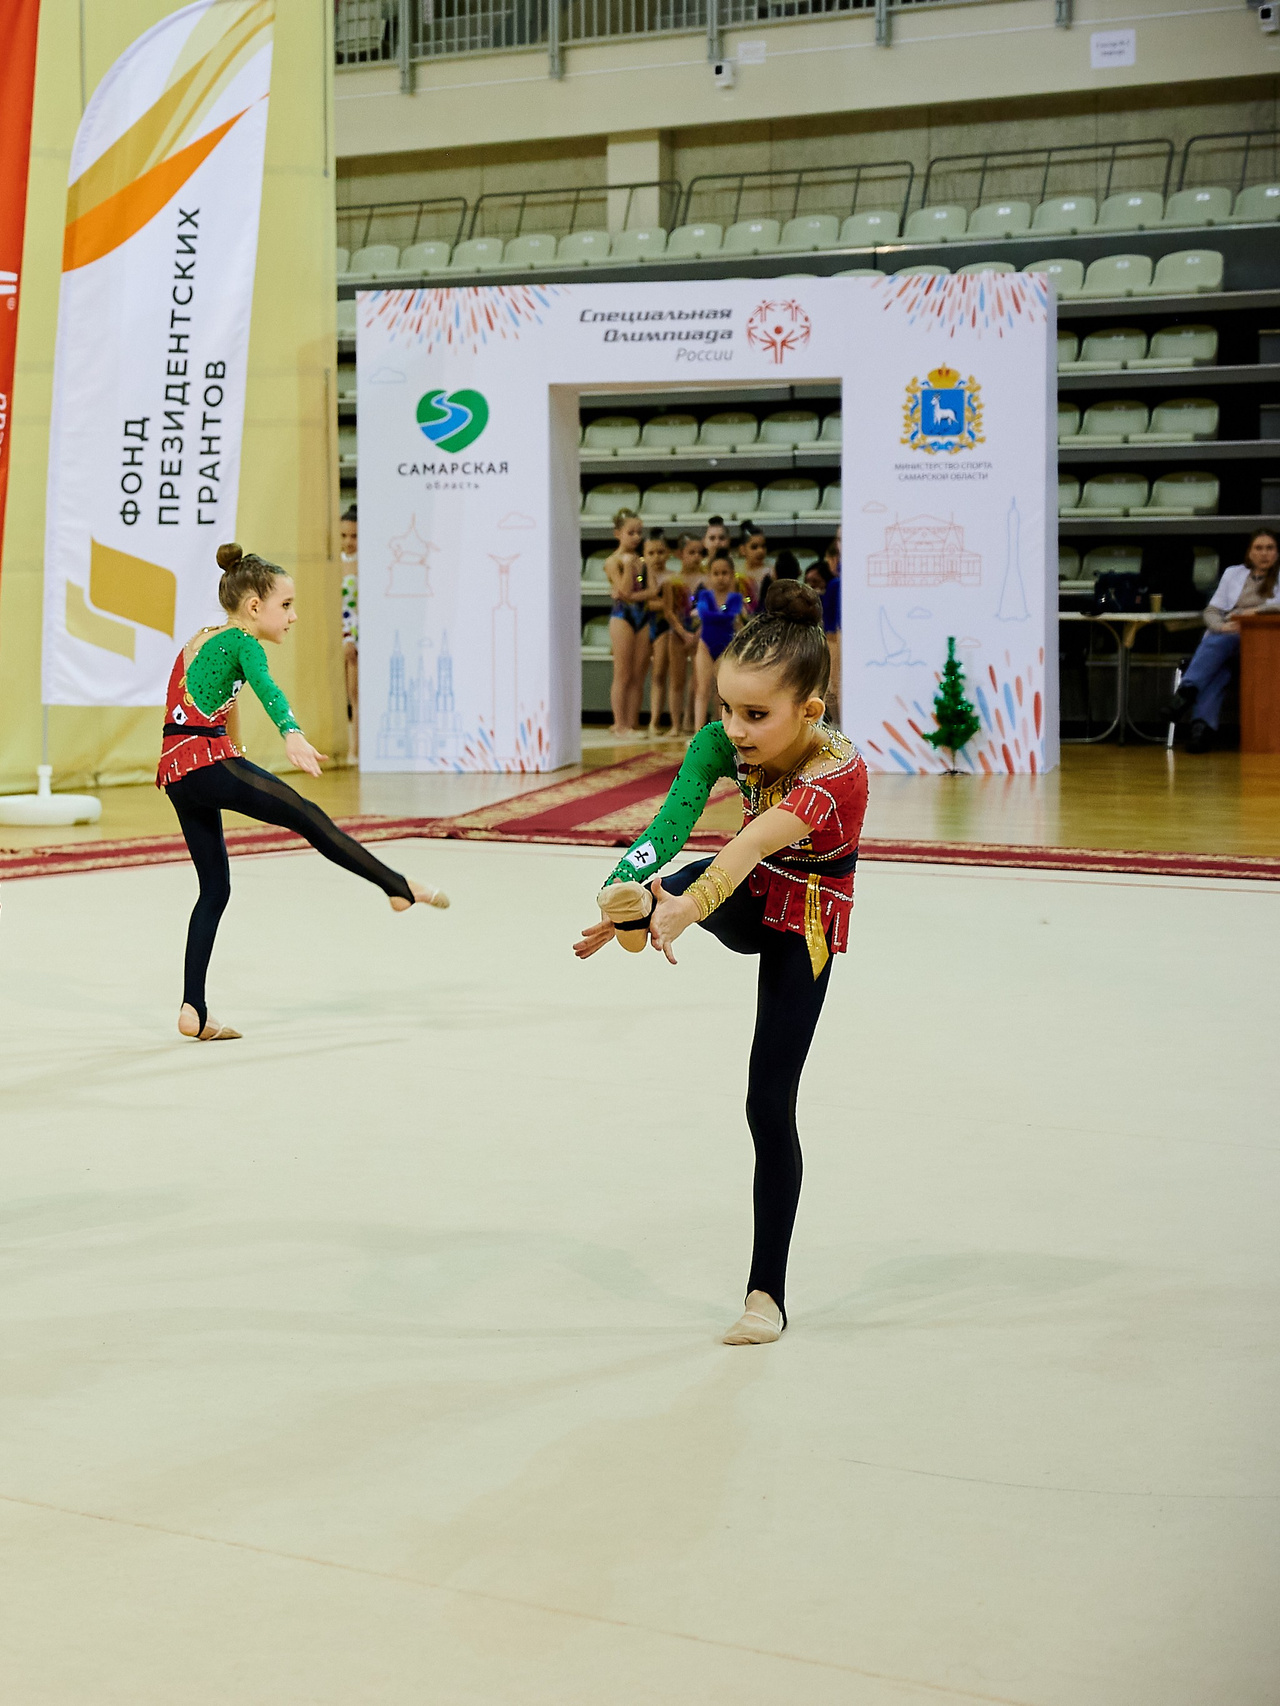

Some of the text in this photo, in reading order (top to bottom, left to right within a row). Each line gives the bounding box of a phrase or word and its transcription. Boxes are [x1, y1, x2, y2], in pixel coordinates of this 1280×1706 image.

[579, 308, 732, 323] Специальная
[603, 328, 733, 344] Олимпиада
[675, 348, 733, 362] России
[158, 207, 200, 525] ПРЕЗИДЕНТСКИХ
[197, 360, 226, 525] ГРАНТОВ
[120, 416, 150, 526] ФОНД
[397, 461, 509, 476] САМАРСКАЯ
[961, 461, 993, 470] СПОРТА
[950, 472, 989, 480] ОБЛАСТИ
